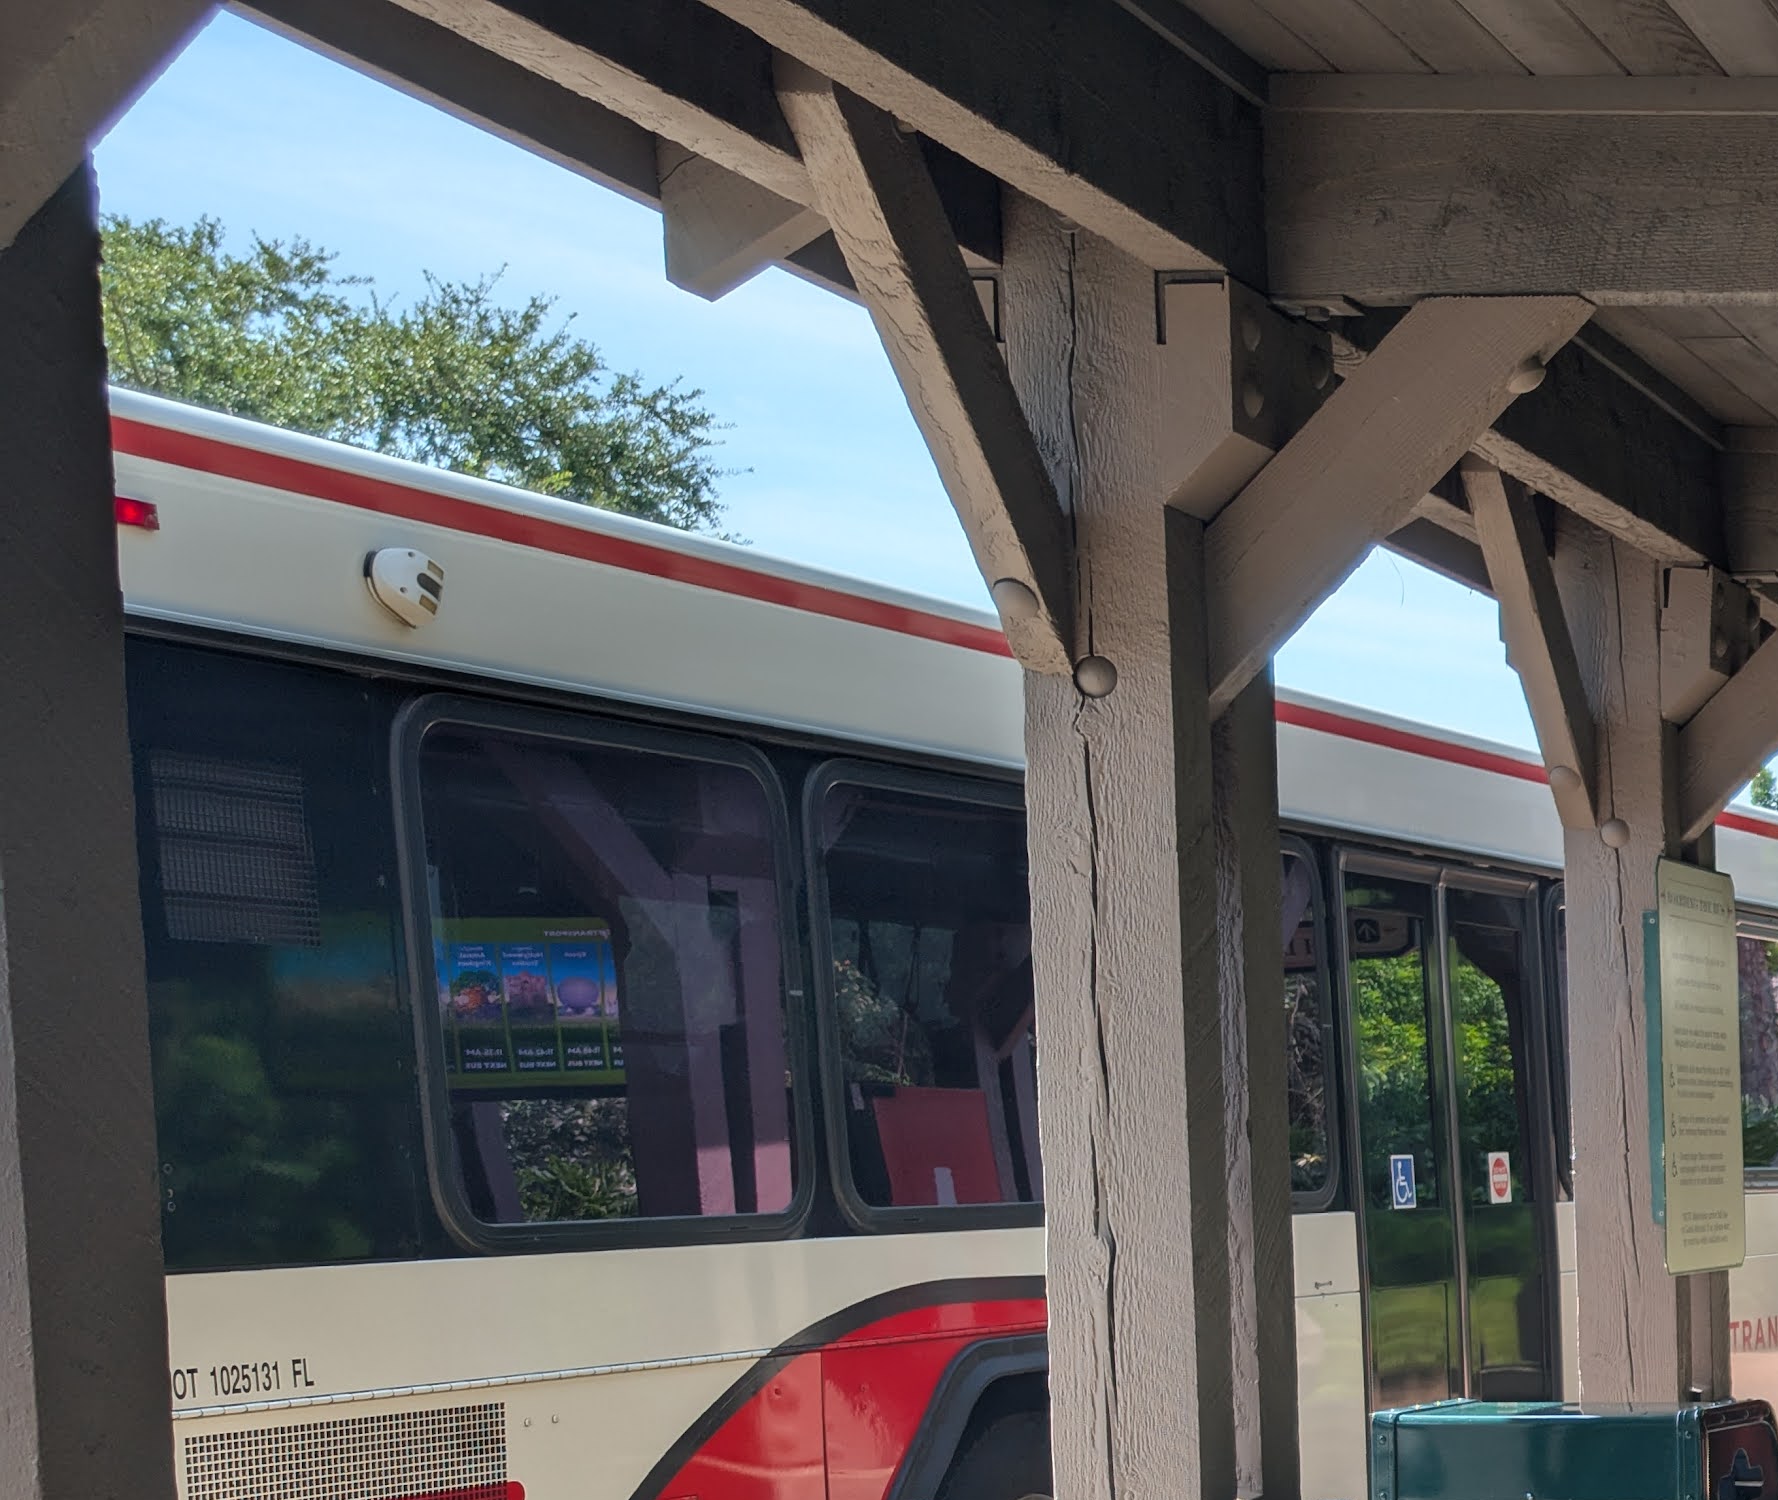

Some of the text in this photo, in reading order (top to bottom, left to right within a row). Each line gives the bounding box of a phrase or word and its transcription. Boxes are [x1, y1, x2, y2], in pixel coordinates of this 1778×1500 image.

[172, 1358, 315, 1400] OT 1025131 FL
